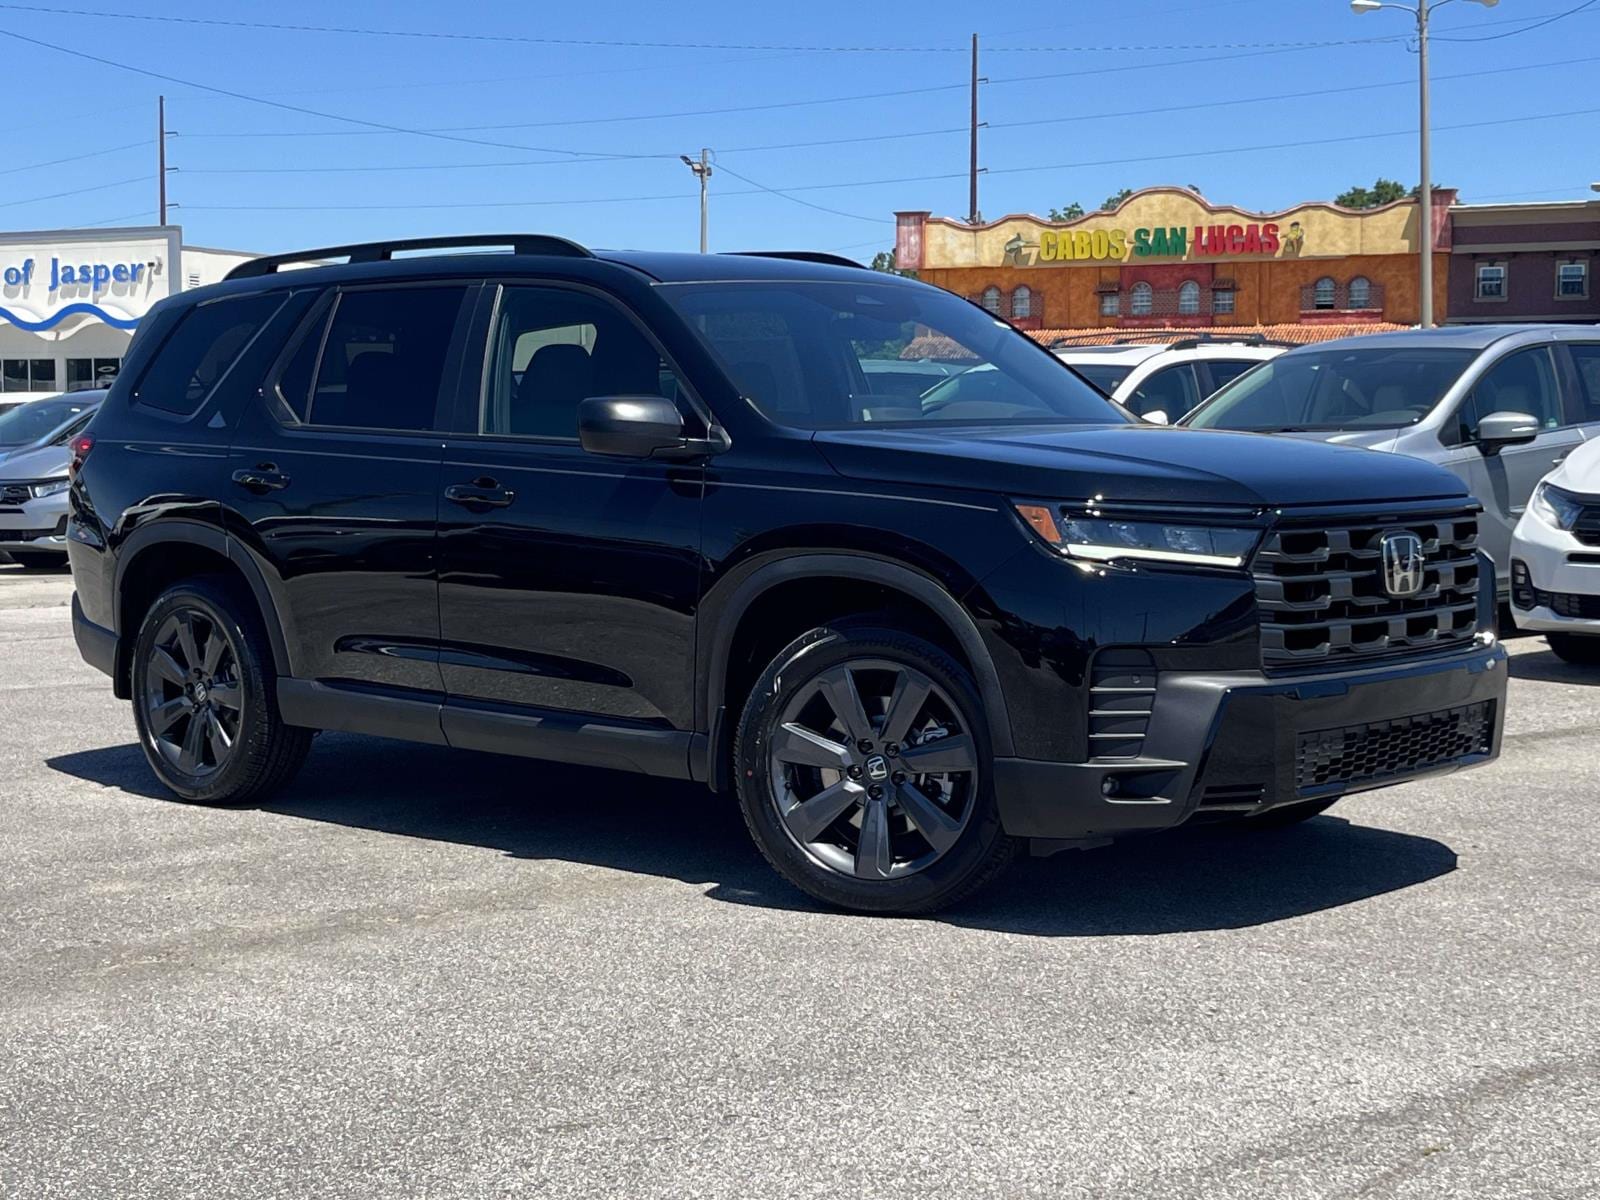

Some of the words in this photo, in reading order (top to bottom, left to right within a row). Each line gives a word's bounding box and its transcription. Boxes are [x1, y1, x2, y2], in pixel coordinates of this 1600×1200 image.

[1040, 229, 1127, 261] CABOS
[1134, 226, 1187, 256] SAN
[1194, 223, 1280, 255] LUCAS
[4, 258, 34, 286] of
[48, 257, 145, 292] Jasper
